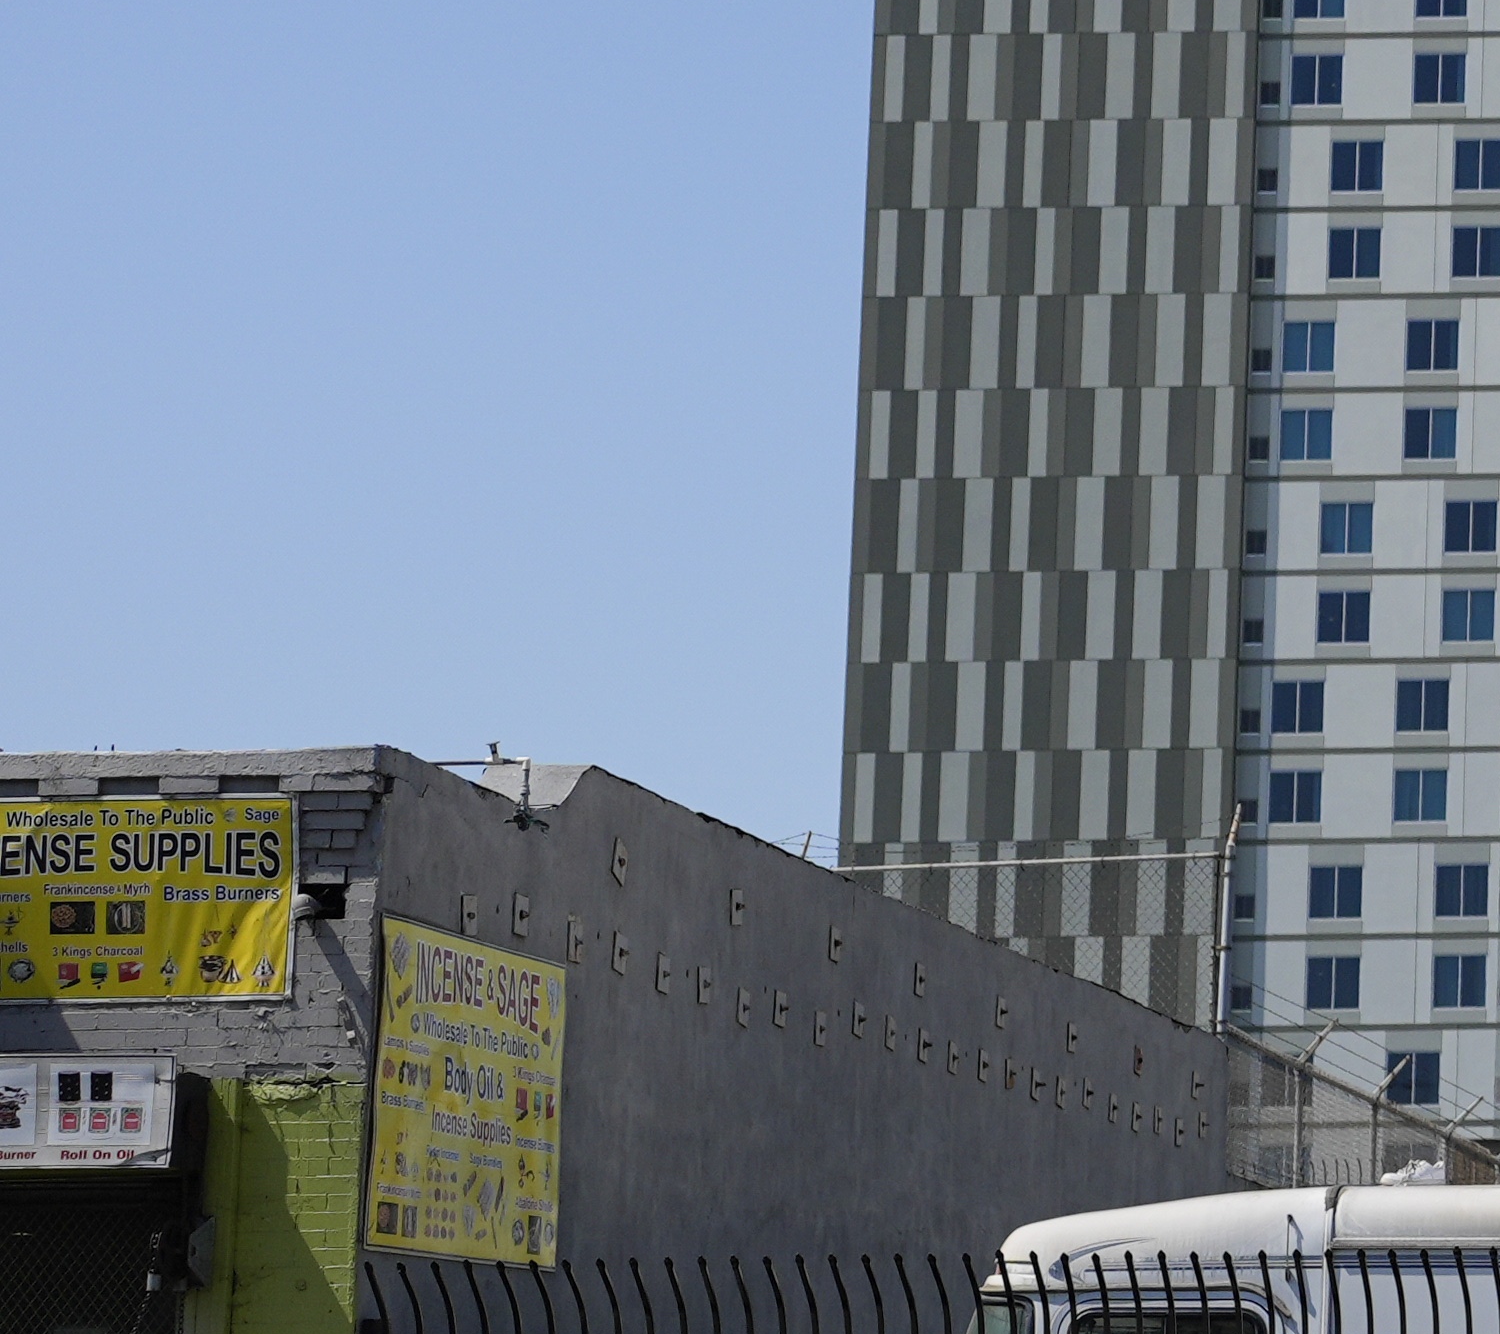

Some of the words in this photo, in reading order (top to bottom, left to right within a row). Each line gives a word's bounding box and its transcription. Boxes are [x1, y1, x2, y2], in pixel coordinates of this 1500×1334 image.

[6, 809, 94, 828] Wholesale
[98, 809, 119, 826] To
[124, 809, 155, 826] The
[161, 807, 214, 825] Public
[244, 807, 280, 823] Sage
[0, 833, 96, 876] ENSE
[109, 830, 281, 879] SUPPLIES
[0, 893, 31, 903] rners
[43, 883, 115, 896] Frankincense
[123, 883, 151, 897] Myrh
[163, 885, 210, 901] Brass
[215, 885, 280, 901] Burners
[52, 947, 58, 957] 3
[61, 947, 92, 959] Kings
[95, 946, 143, 957] Charcoal
[416, 941, 485, 1009] INCENSE
[486, 968, 495, 1002] &
[496, 964, 541, 1035] SAGE
[423, 1012, 468, 1046] Wholesale
[470, 1024, 480, 1048] To
[482, 1027, 499, 1052] The
[501, 1031, 529, 1059] Public
[444, 1055, 474, 1105] Body
[476, 1064, 494, 1101] Oil
[496, 1071, 504, 1100] &
[431, 1104, 468, 1137] Incense
[470, 1112, 512, 1149] Supplies
[60, 1149, 87, 1160] Roll
[93, 1149, 111, 1160] On
[116, 1149, 135, 1160] Oil
